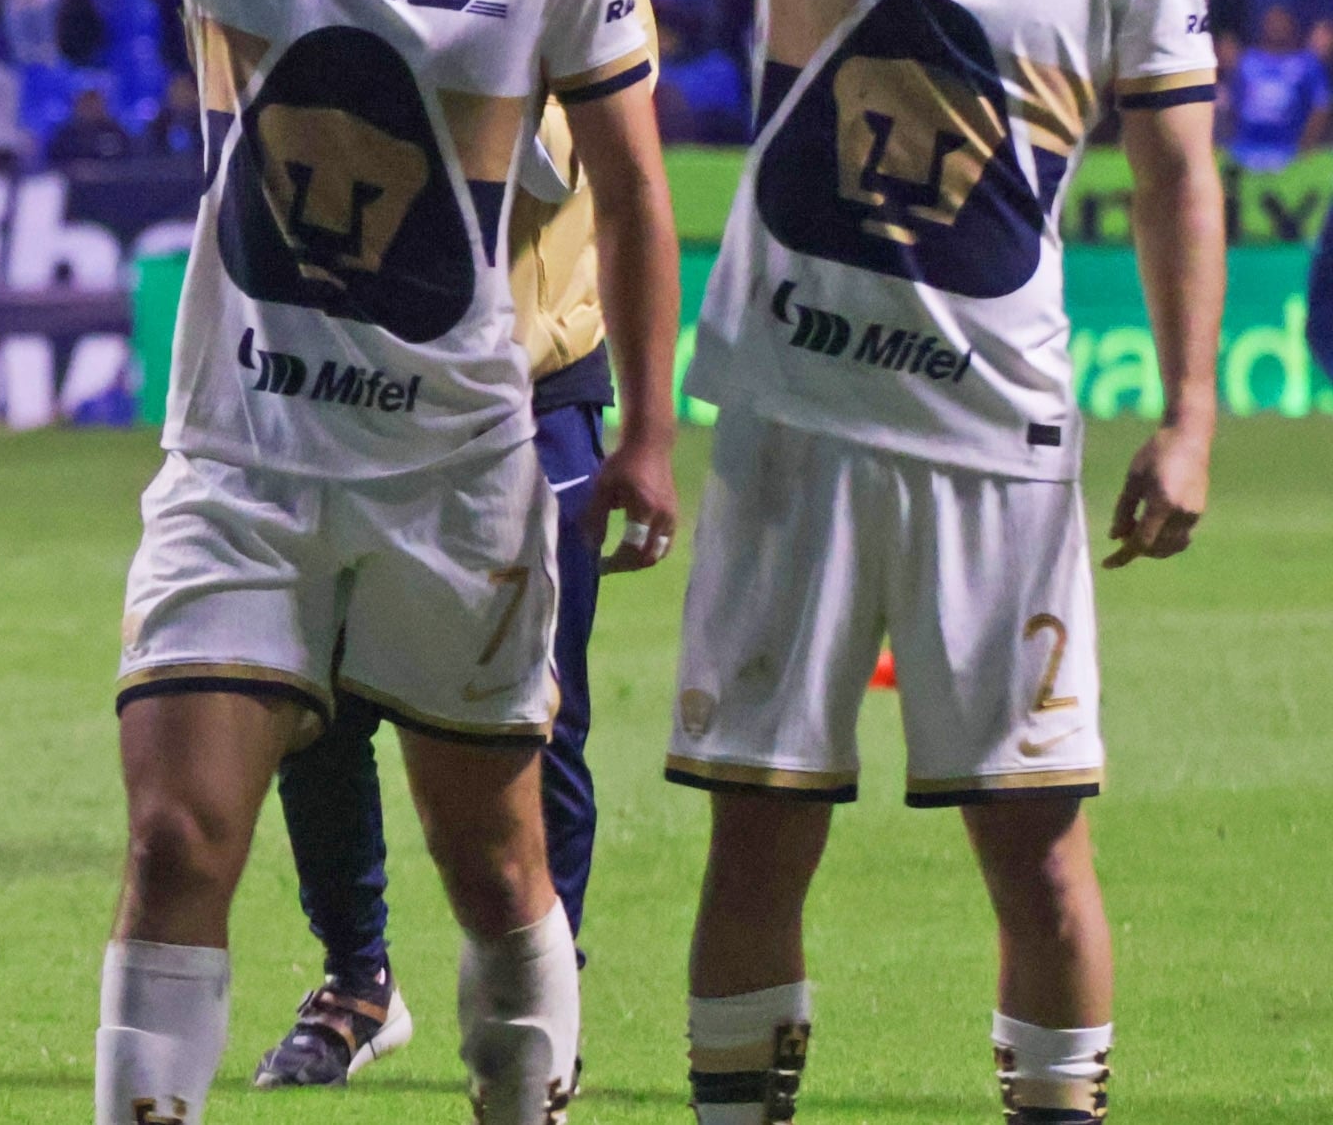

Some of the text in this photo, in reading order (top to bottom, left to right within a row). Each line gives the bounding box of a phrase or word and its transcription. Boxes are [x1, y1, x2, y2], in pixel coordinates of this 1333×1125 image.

[308, 360, 423, 415] Mifel
[854, 325, 973, 384] Mifel
[476, 567, 530, 666] 7
[1022, 612, 1081, 713] 2
